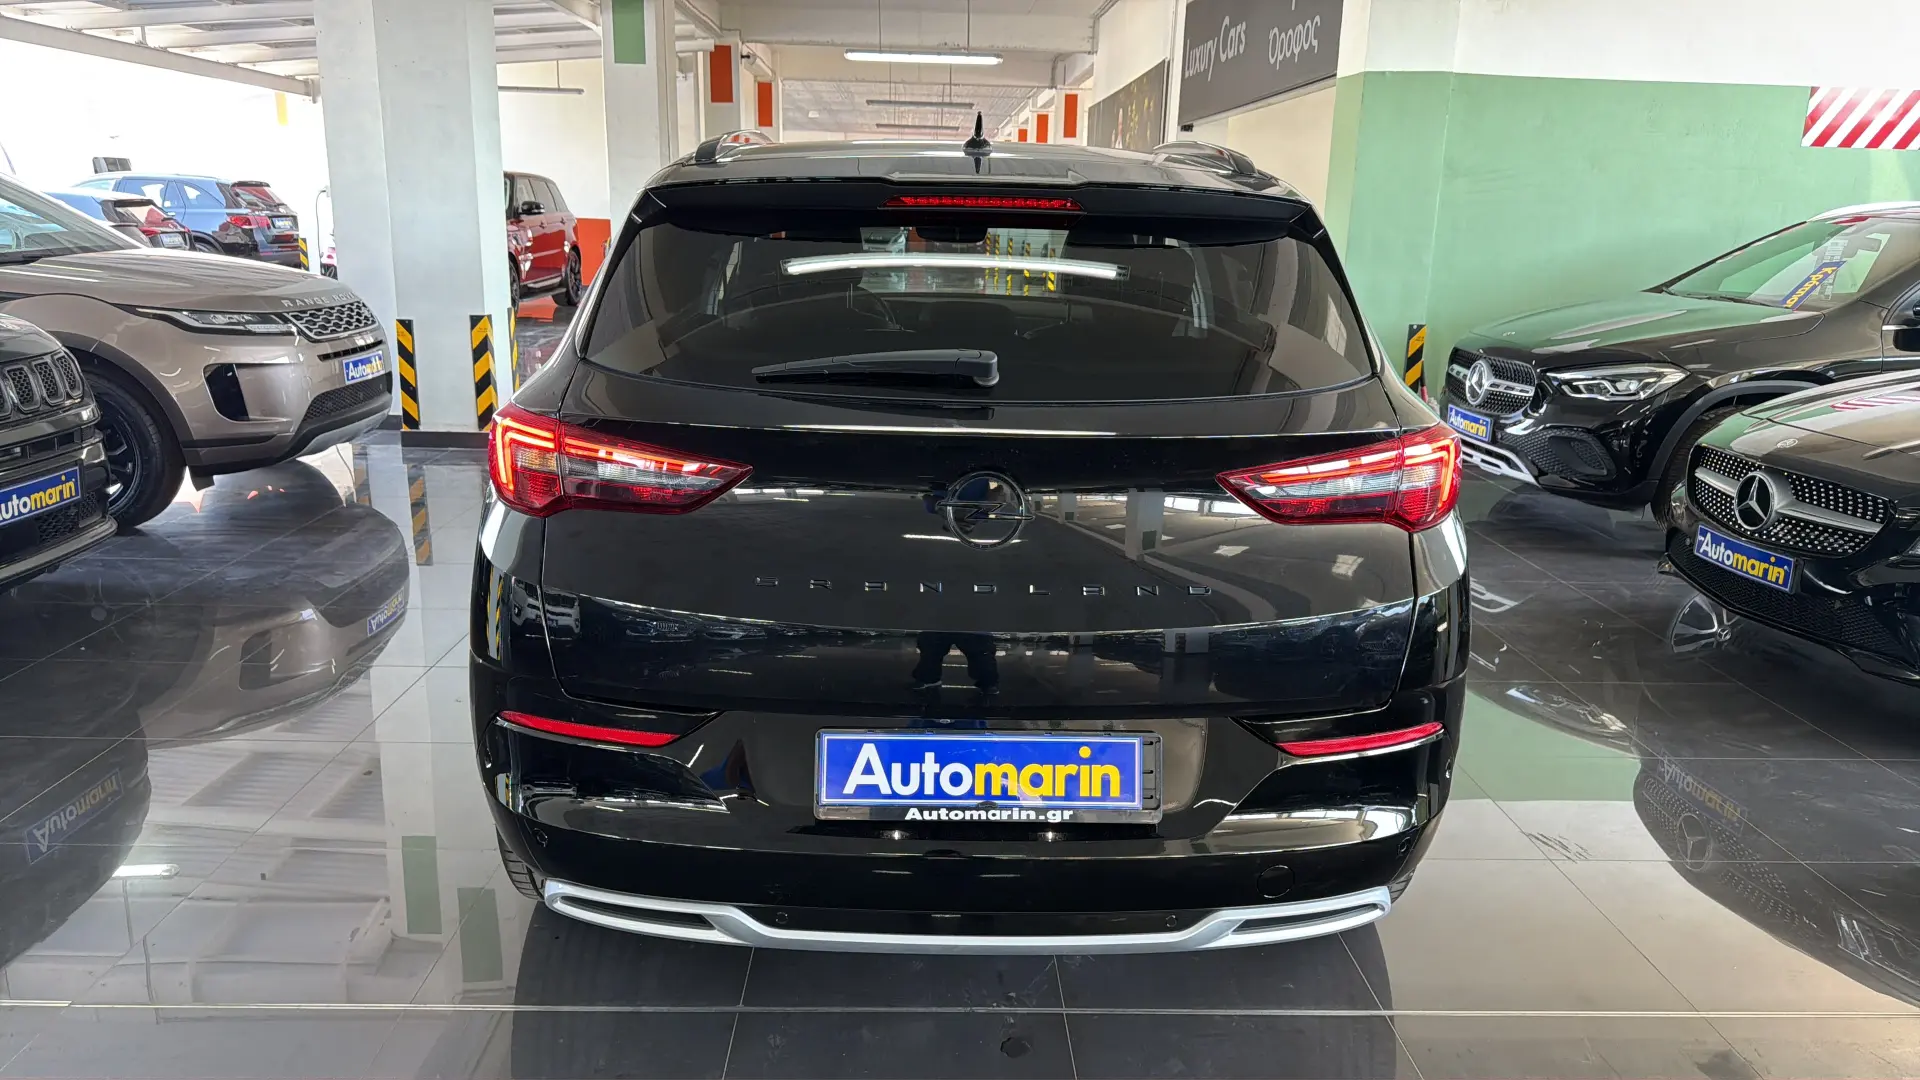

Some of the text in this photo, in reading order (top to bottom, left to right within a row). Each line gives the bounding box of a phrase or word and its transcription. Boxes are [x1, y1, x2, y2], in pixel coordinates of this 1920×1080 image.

[1184, 15, 1247, 83] Luxury Cars
[281, 296, 330, 308] RANGE
[0, 474, 76, 521] utomarin
[1699, 531, 1785, 585] Automarin
[842, 743, 1121, 798] Automarin
[904, 807, 1074, 823] Automarin.gr
